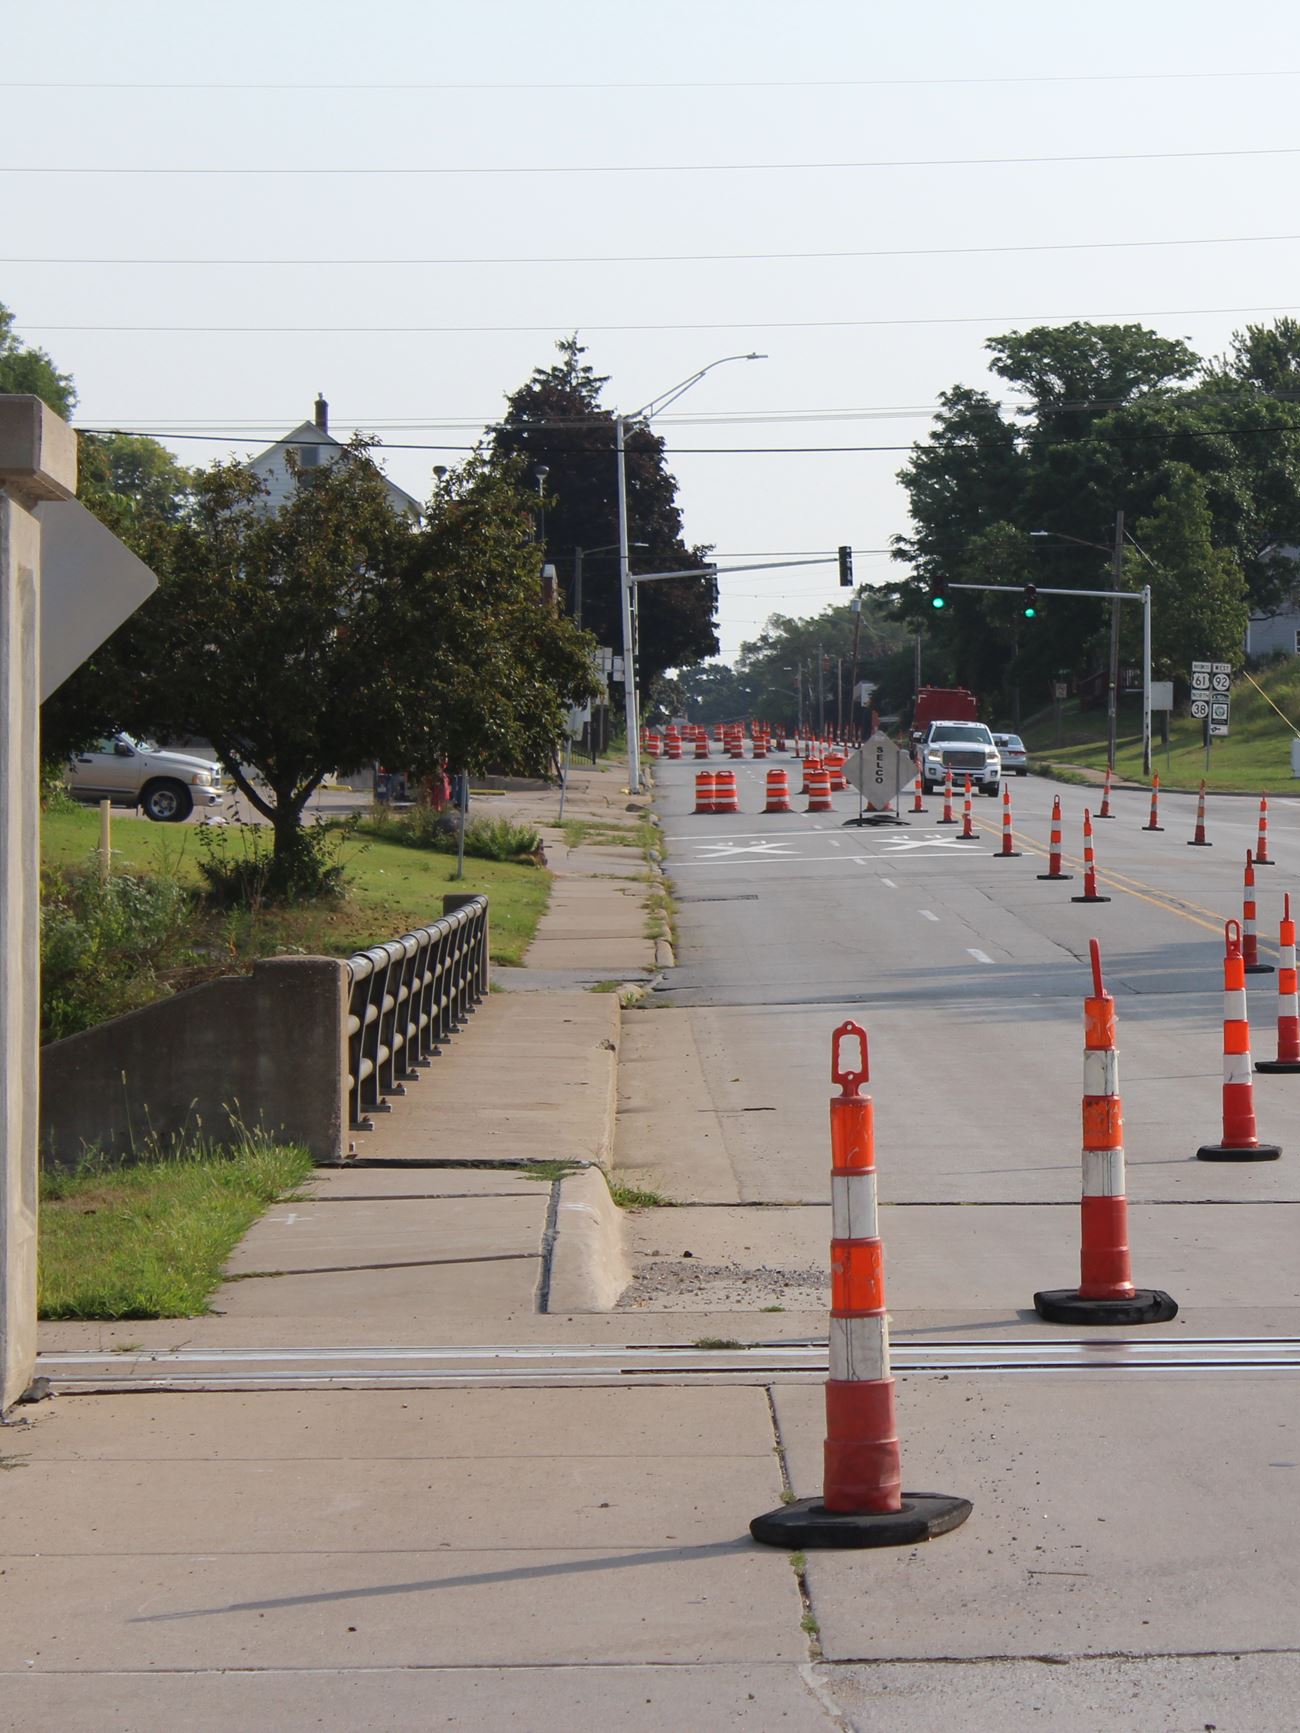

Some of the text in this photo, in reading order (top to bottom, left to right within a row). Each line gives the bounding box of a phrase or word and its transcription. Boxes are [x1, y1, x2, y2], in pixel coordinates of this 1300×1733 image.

[1195, 676, 1206, 686] 61
[1215, 676, 1228, 687] 92
[1193, 704, 1206, 715] 38
[875, 746, 884, 784] SELCO
